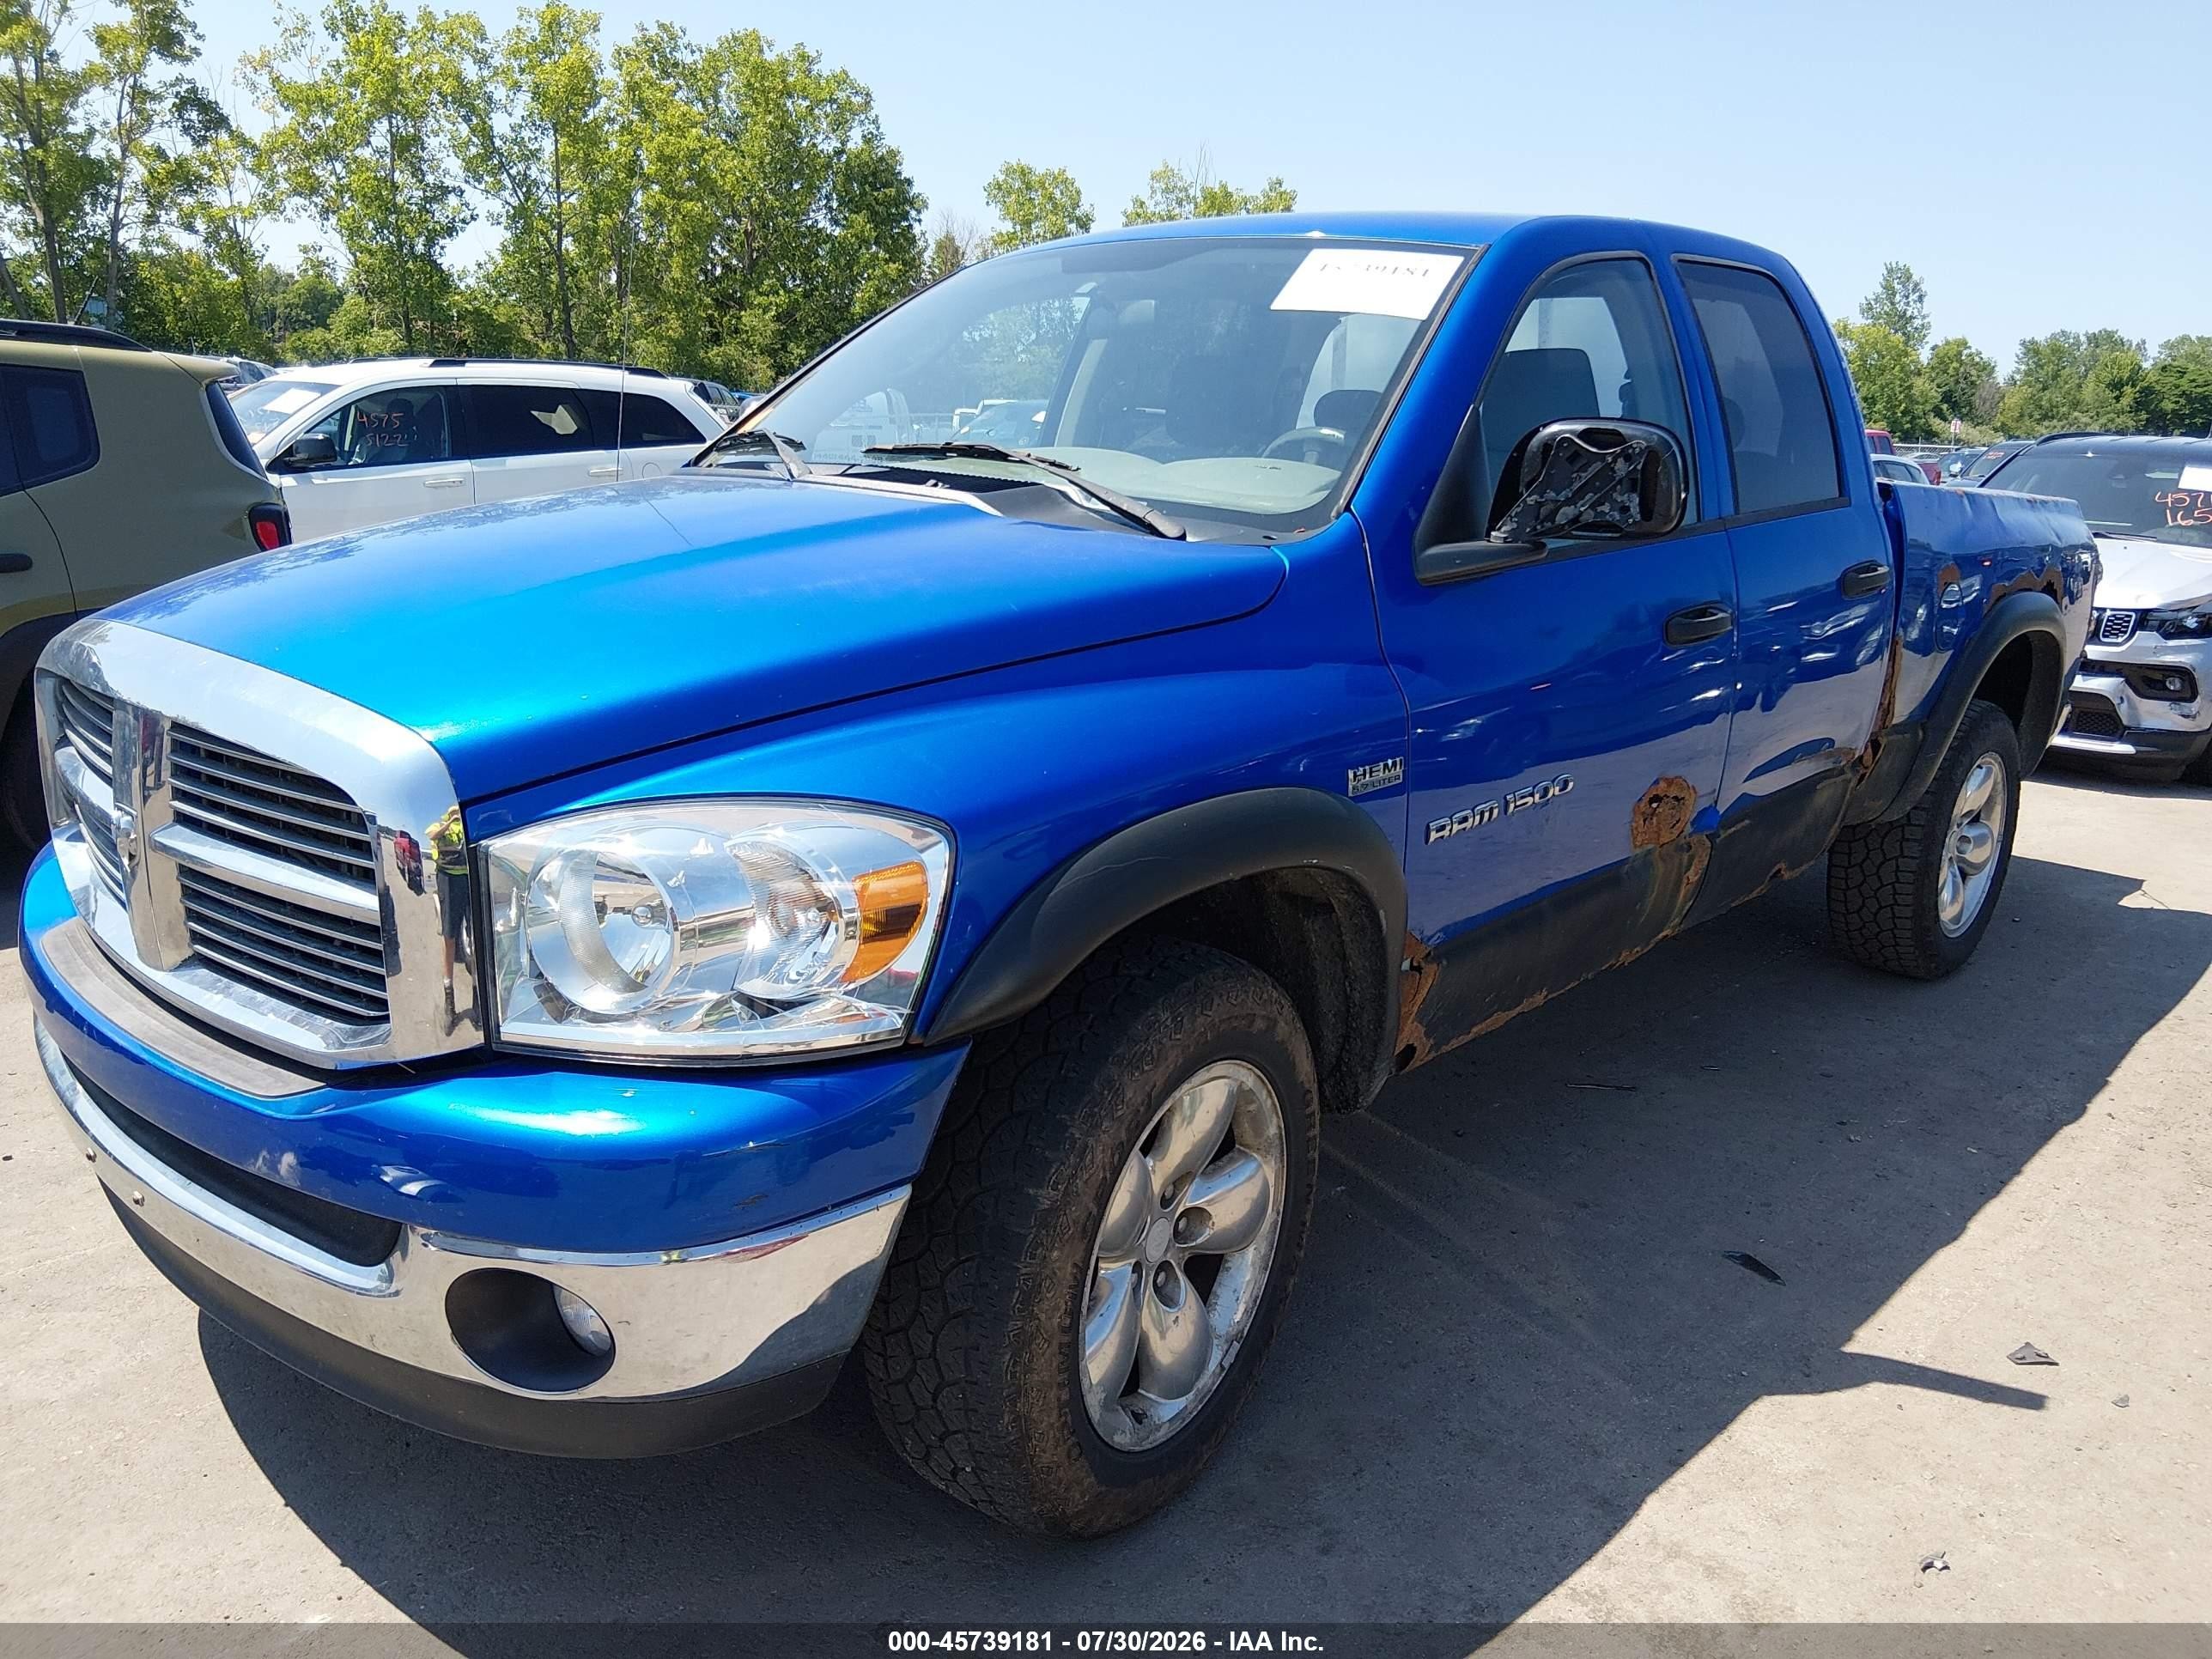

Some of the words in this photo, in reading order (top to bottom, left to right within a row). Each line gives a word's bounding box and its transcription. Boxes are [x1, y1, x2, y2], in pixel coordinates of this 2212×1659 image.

[356, 410, 404, 428] 4575
[1352, 757, 1403, 783] HEMI
[1372, 774, 1401, 788] LITER
[1425, 799, 1499, 845] RAM
[1504, 773, 1575, 817] 1500
